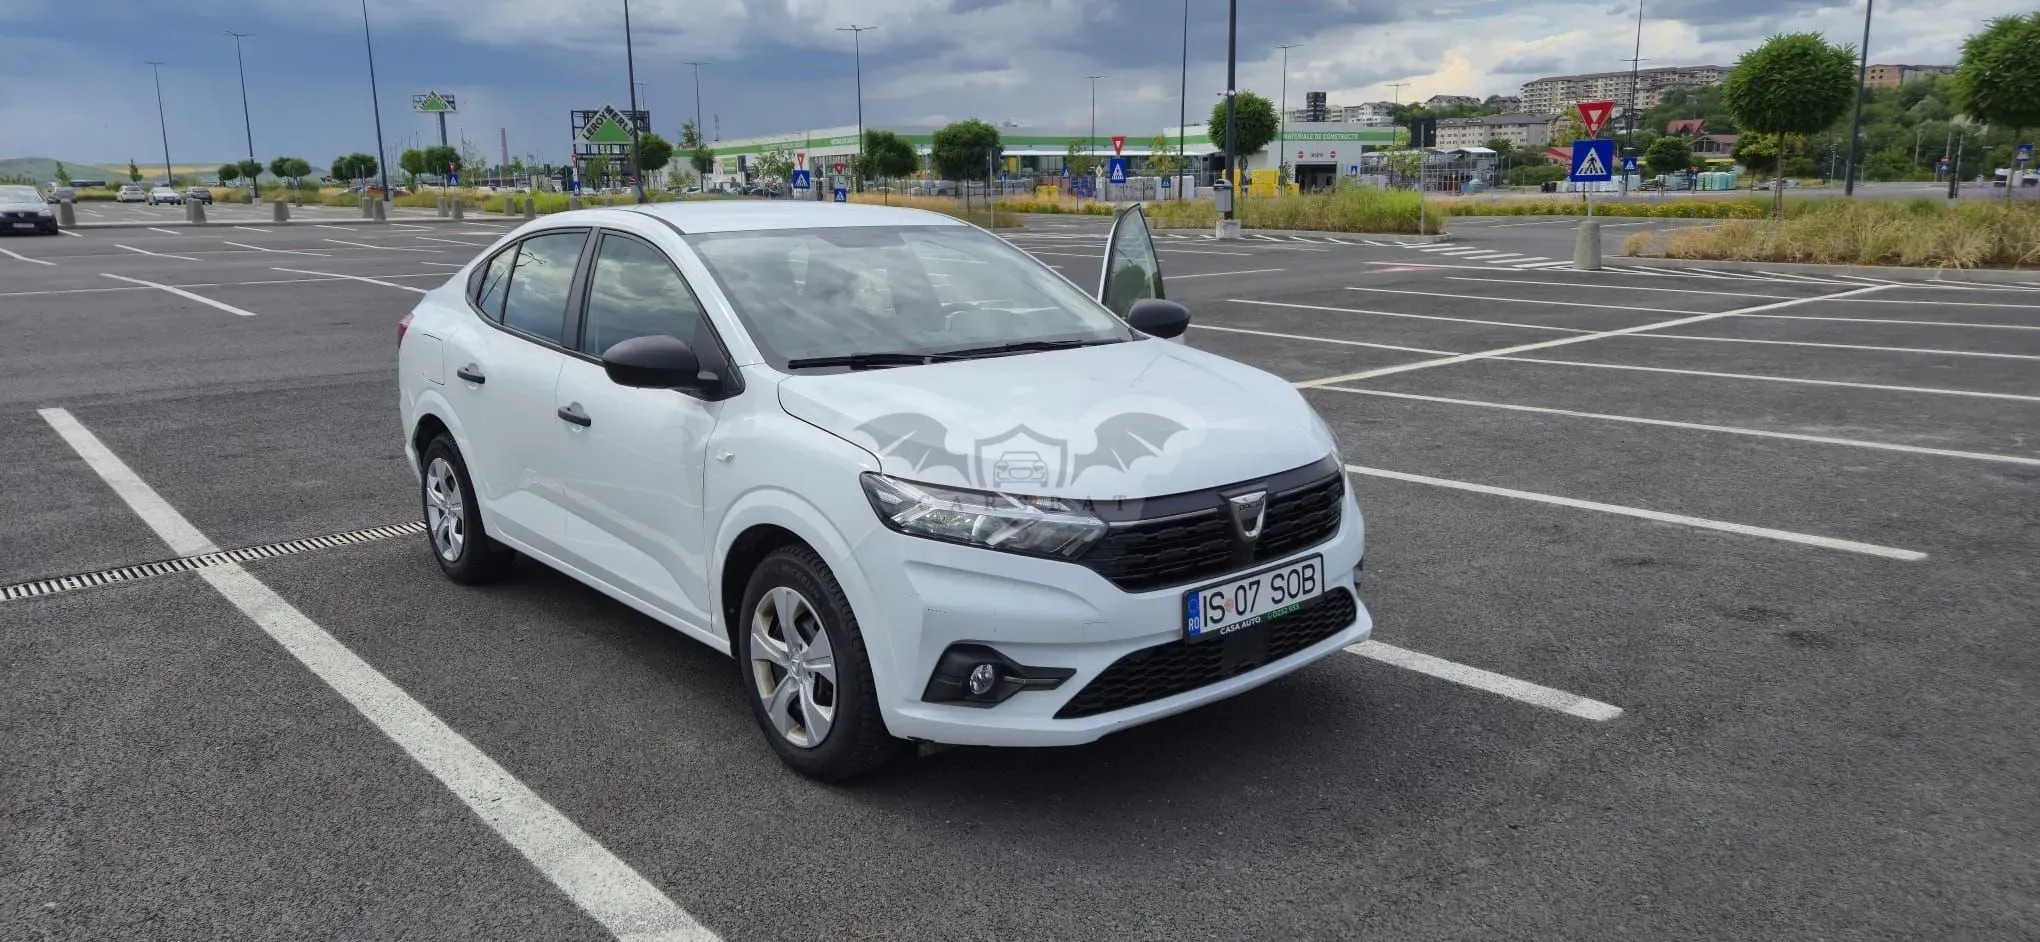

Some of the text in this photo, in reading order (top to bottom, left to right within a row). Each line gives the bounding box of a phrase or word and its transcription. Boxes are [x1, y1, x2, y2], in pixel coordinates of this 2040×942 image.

[582, 105, 634, 140] LEROY MERLI
[1203, 563, 1316, 627] IS 07 SOB
[1188, 617, 1200, 632] RO
[1220, 616, 1261, 635] CASA AUTO
